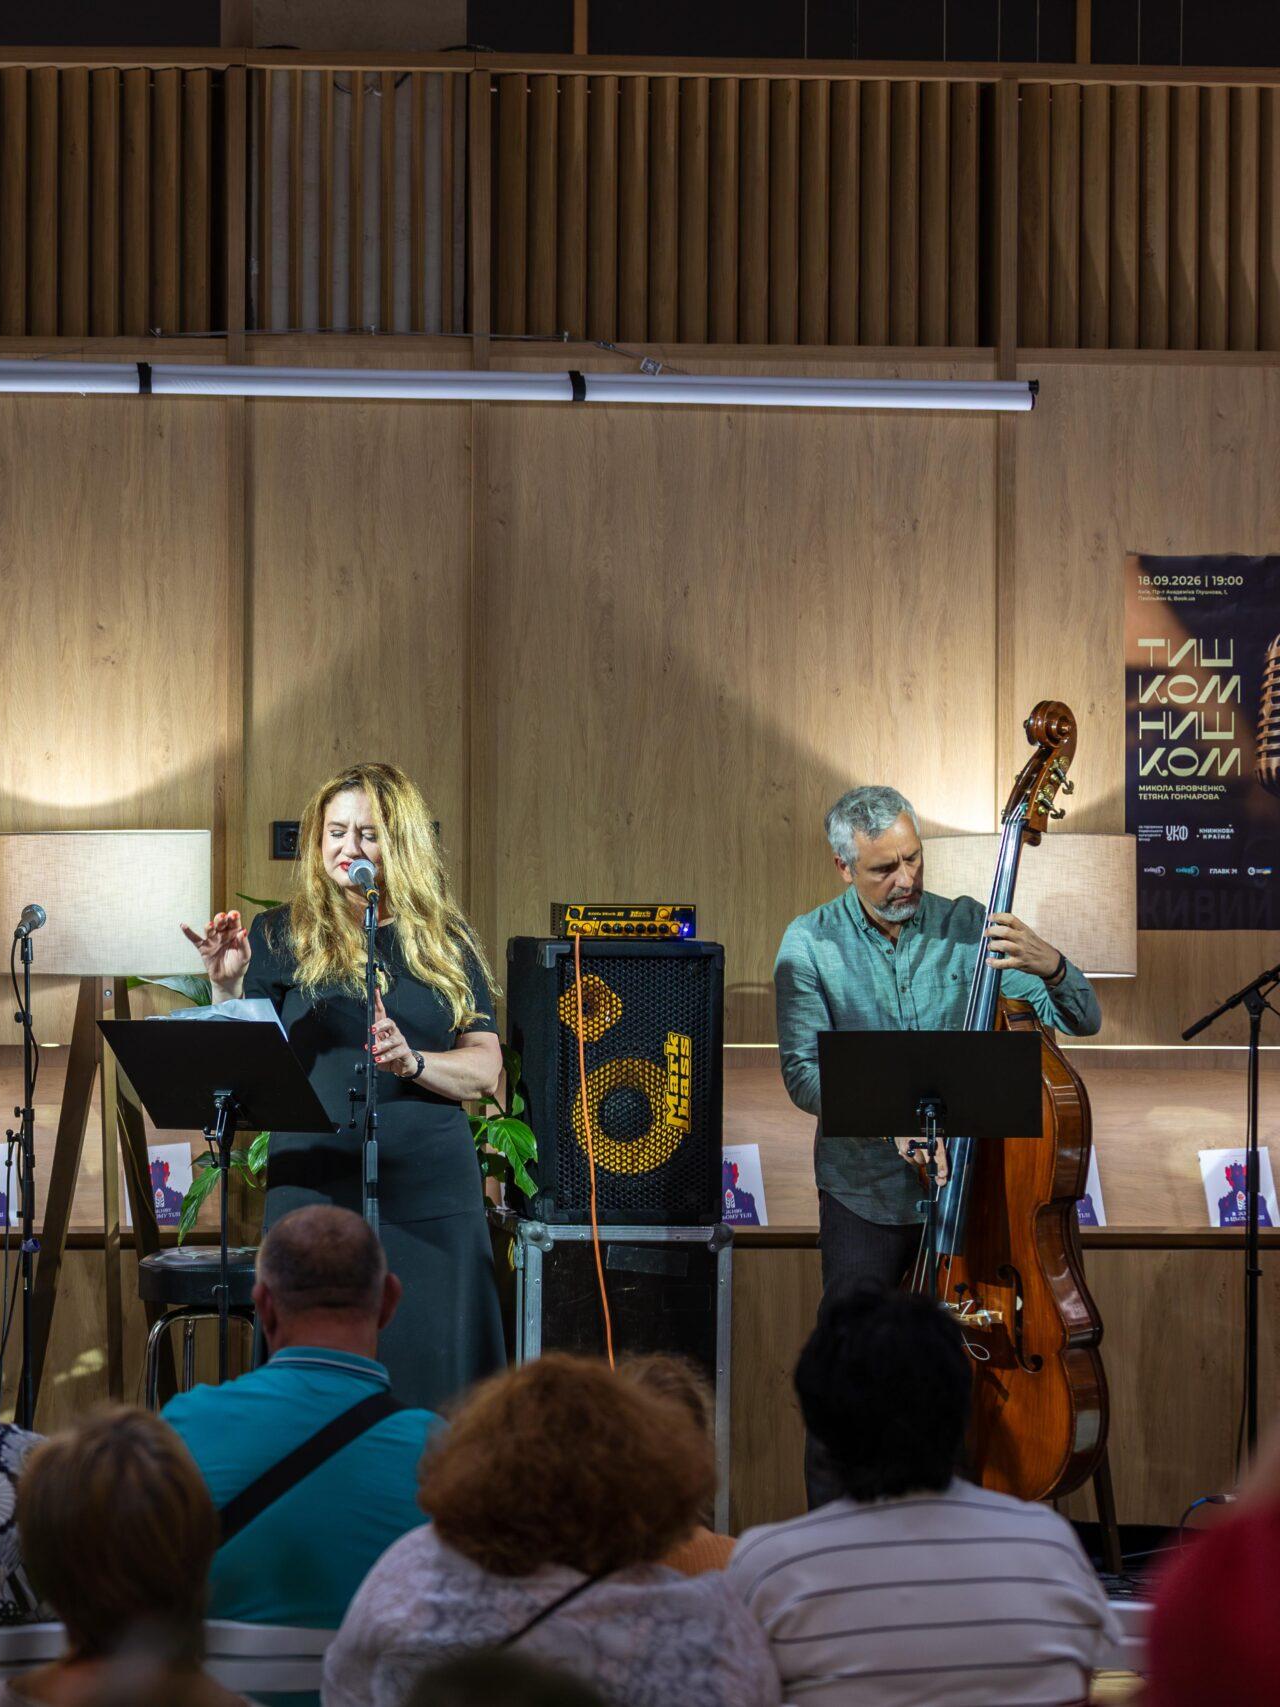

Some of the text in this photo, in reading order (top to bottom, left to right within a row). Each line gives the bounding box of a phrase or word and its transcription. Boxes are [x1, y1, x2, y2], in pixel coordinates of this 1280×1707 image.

[1138, 575, 1202, 587] 18.09.2026
[1211, 575, 1244, 587] 19:00
[1137, 638, 1234, 668] ТИШ
[1138, 674, 1241, 705] КОМ
[1138, 711, 1235, 740] НИШ
[1138, 747, 1241, 777] КОМ
[1175, 785, 1227, 793] БРОВЧЕНКО,
